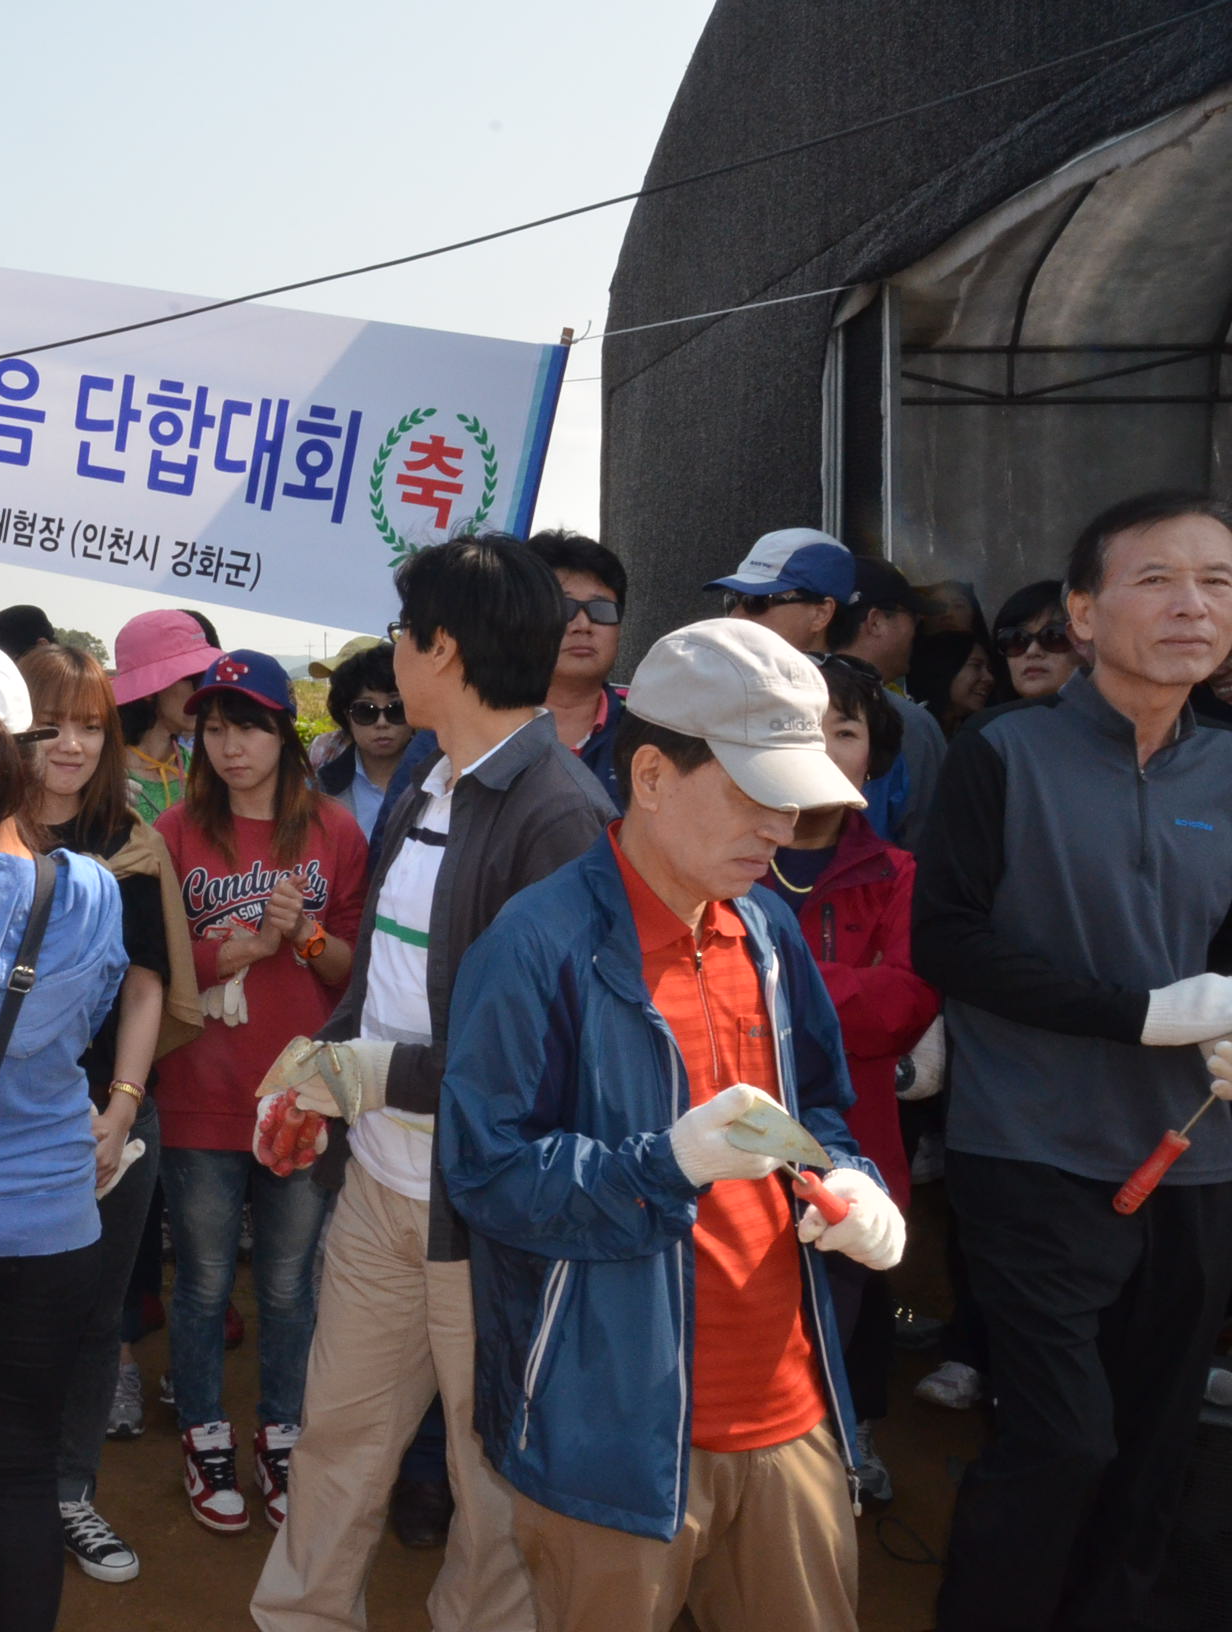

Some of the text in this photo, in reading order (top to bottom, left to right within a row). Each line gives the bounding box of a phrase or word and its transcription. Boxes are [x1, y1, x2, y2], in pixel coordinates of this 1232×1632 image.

[74, 374, 363, 525] 단합대회
[396, 434, 464, 530] 축
[70, 519, 161, 571] (인천시
[170, 540, 262, 592] 강화군)
